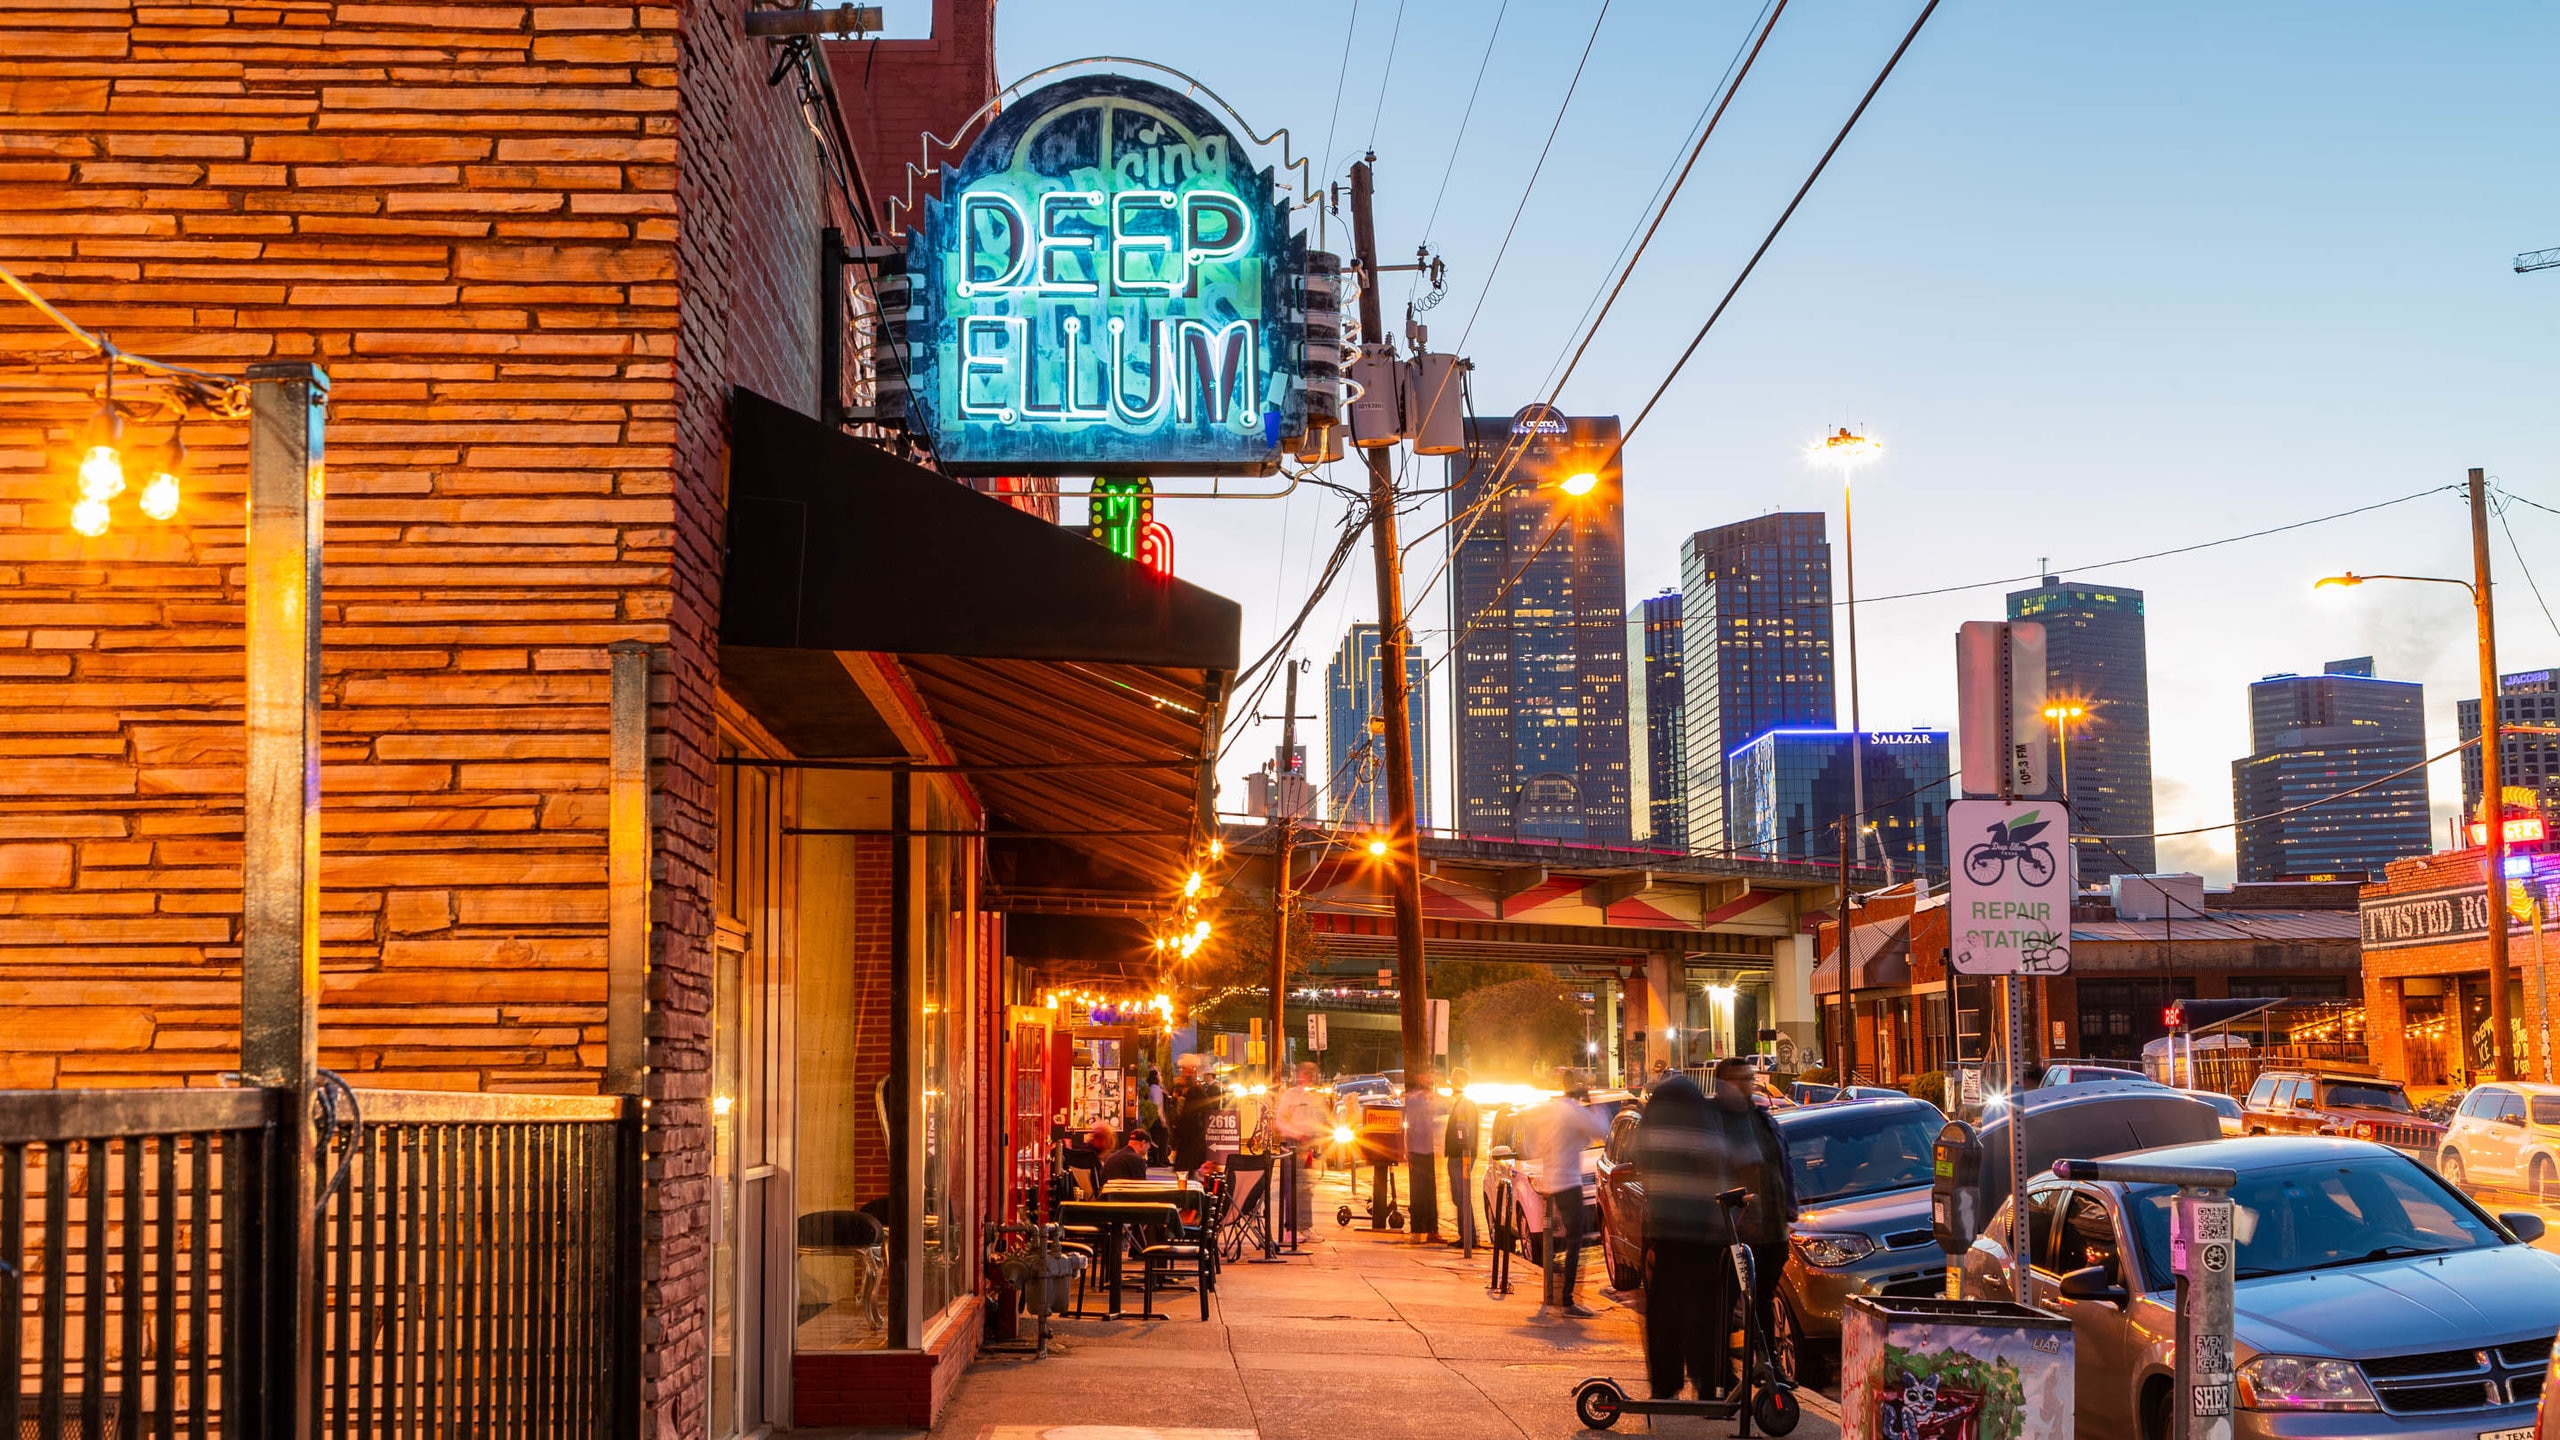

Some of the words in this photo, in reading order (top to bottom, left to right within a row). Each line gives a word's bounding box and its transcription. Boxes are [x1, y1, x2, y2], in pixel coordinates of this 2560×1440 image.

[959, 189, 1252, 297] DEEP
[958, 316, 1259, 426] ELLUM
[2504, 671, 2550, 686] JACOBS
[1871, 732, 1932, 745] SALAZAR
[2015, 744, 2028, 759] FM
[1972, 902, 2050, 921] REPAIR
[2366, 899, 2453, 940] TWISTED
[2165, 1008, 2180, 1025] RBC
[1209, 1115, 1237, 1128] 2616
[2196, 1336, 2223, 1347] EVEN
[2506, 1430, 2535, 1440] TEXA
